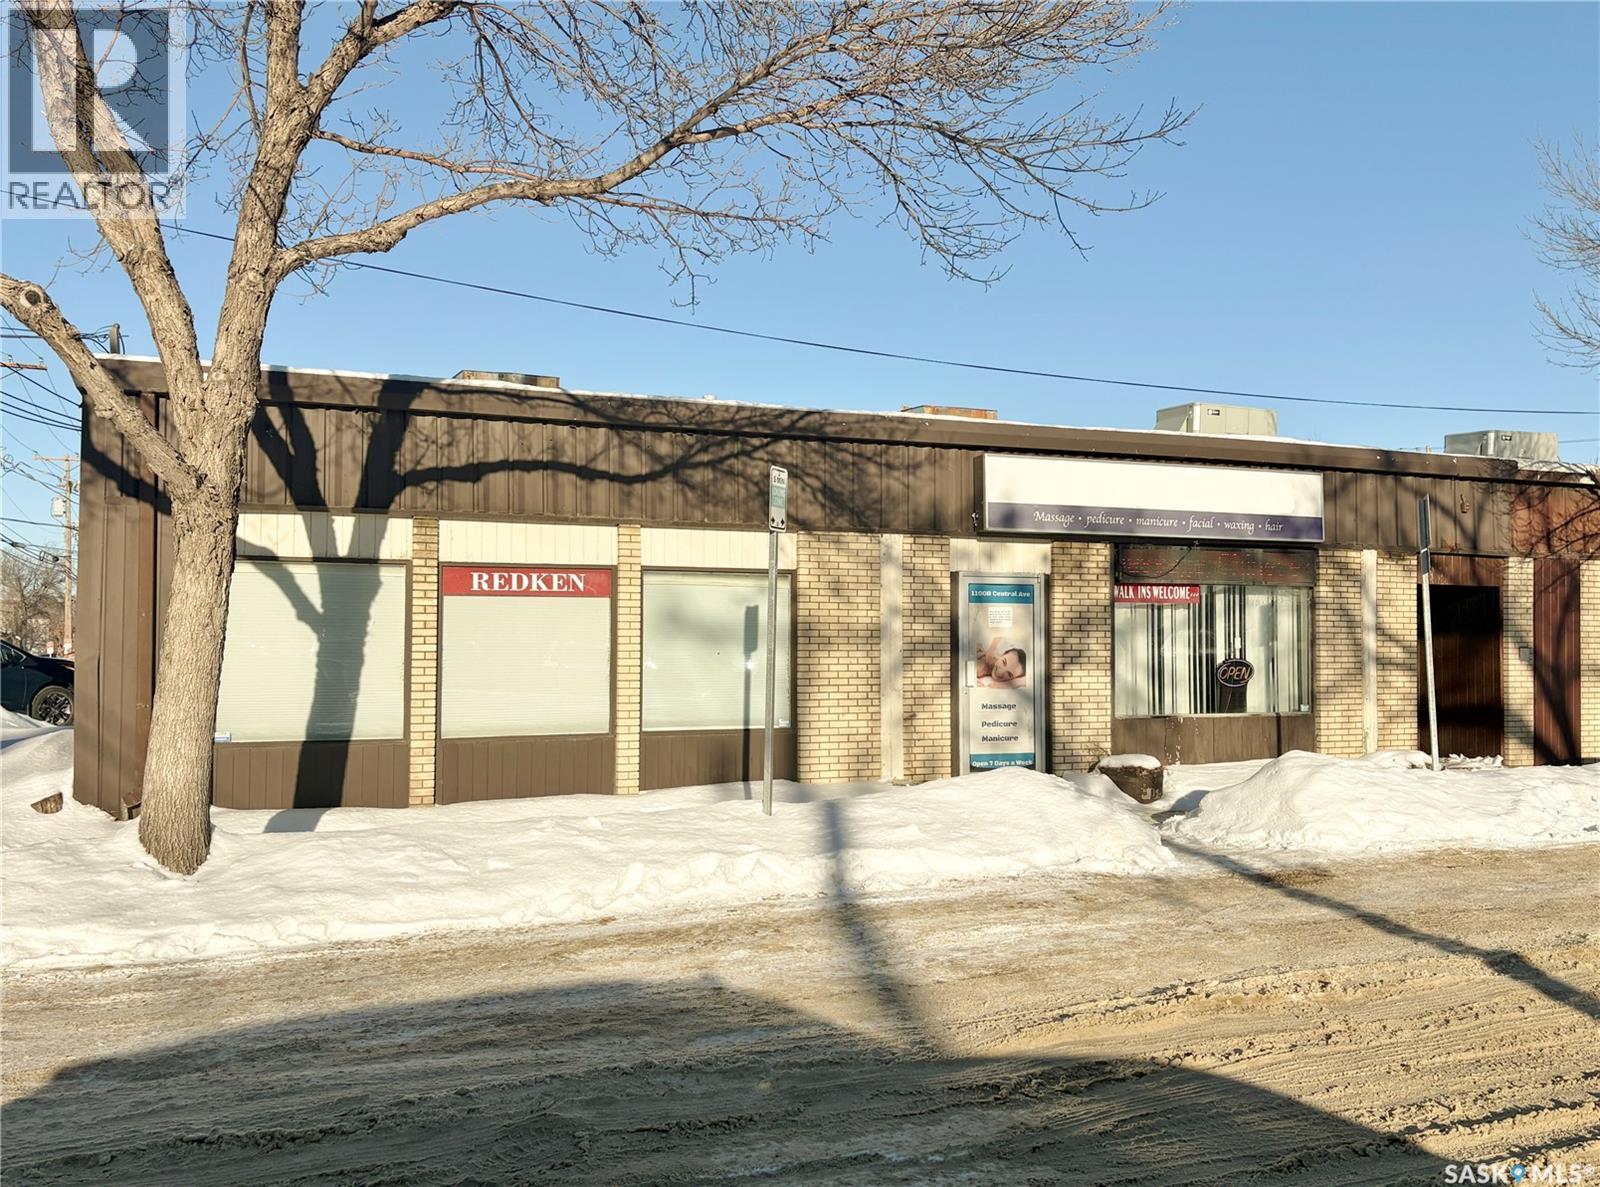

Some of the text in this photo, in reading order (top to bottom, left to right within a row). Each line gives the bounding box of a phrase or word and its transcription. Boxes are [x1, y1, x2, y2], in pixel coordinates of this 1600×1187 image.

[1033, 511, 1284, 535] Massage pedicure manicure facial waxing hair
[470, 572, 586, 592] REDKEN
[1138, 585, 1151, 599] INS
[1220, 666, 1250, 680] OPEN
[981, 703, 1017, 711] Massage
[981, 720, 1018, 728] Pedicure
[972, 760, 988, 768] Open
